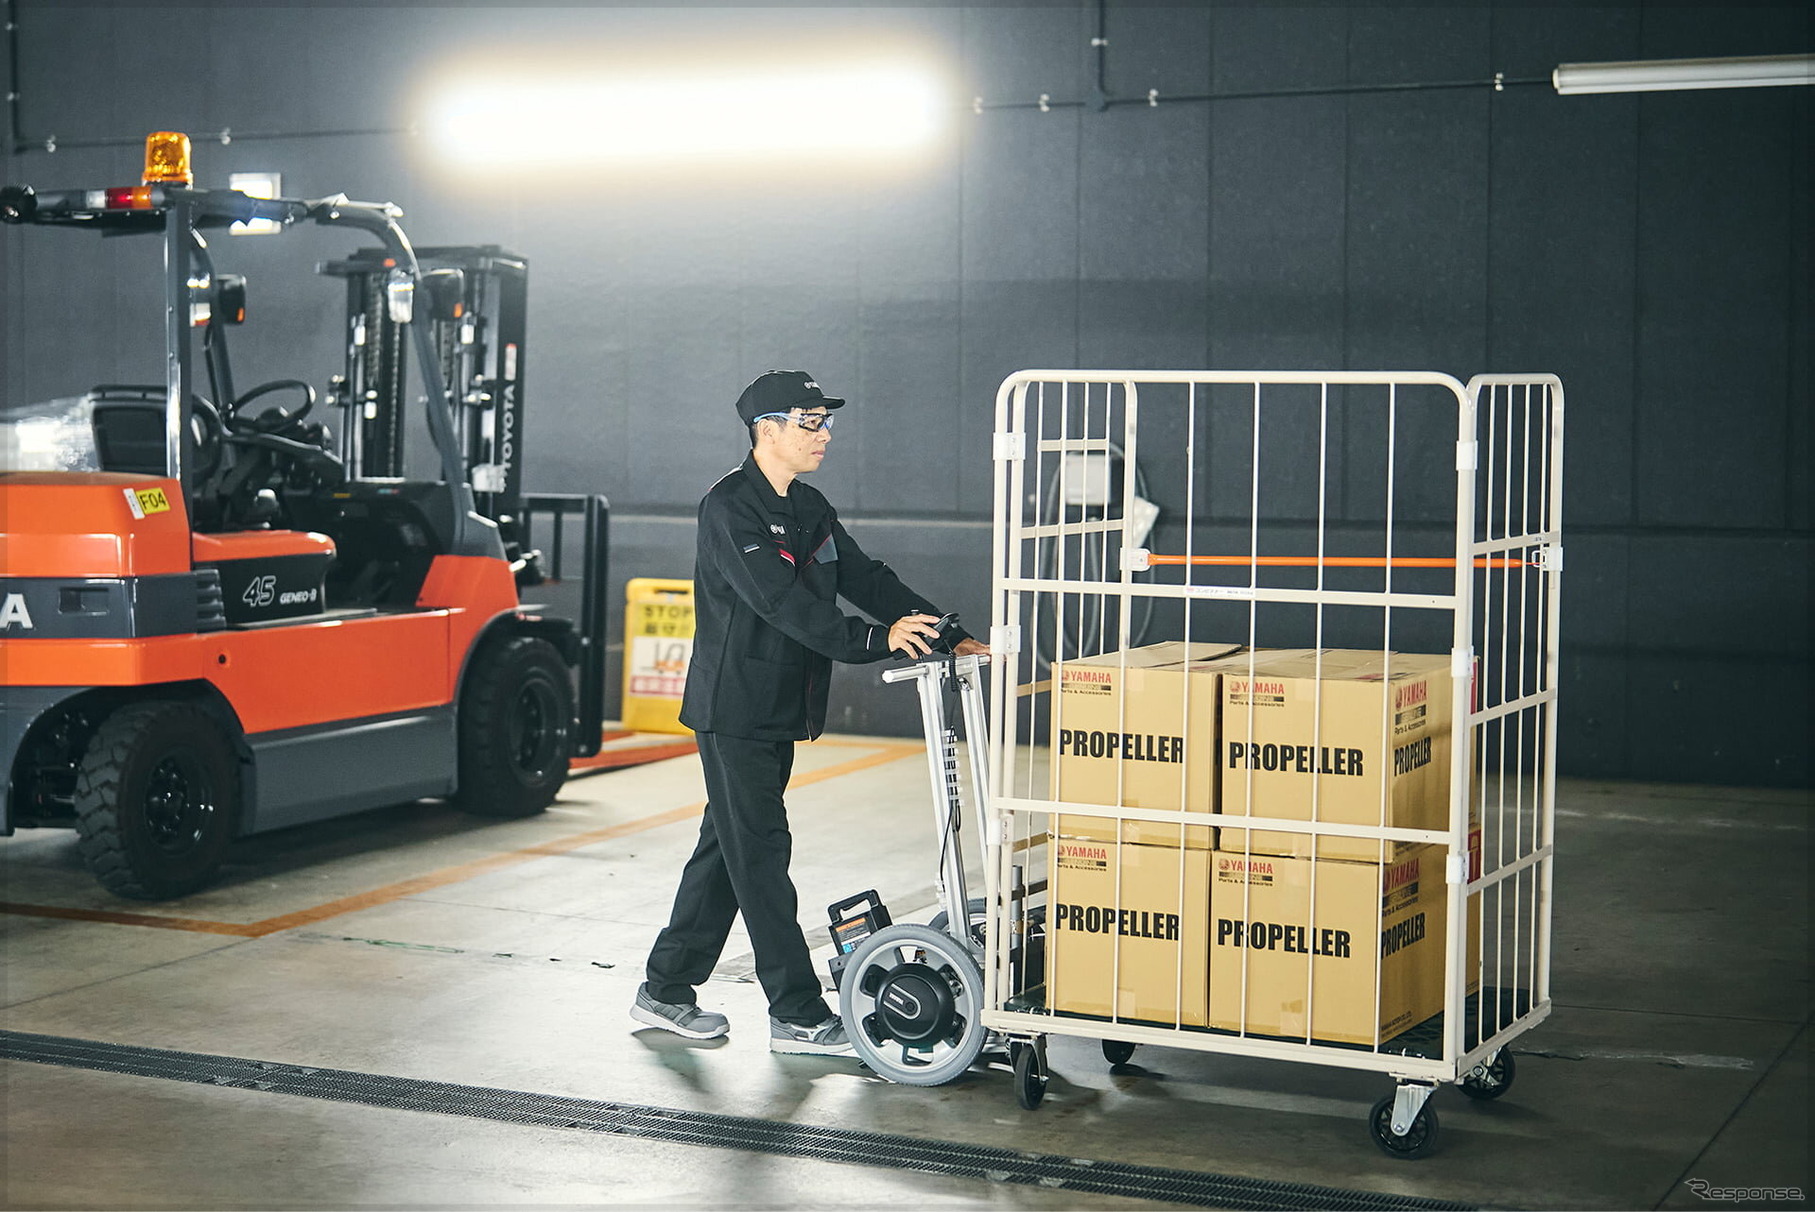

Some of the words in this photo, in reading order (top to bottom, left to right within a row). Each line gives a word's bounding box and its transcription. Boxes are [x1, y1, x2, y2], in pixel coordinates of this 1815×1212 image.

[139, 492, 166, 510] F04
[242, 575, 277, 608] 45
[644, 606, 693, 618] STOP
[1071, 671, 1112, 683] YAMAHA
[1242, 682, 1285, 694] YMAHA
[1402, 680, 1427, 708] YAMAHA
[1060, 729, 1184, 764] PROPELLER
[1229, 742, 1364, 776] PROPELLER
[1394, 736, 1432, 777] PROPELLER
[1066, 846, 1108, 860] YAMAHA
[1390, 858, 1420, 888] YAMAHA
[1056, 903, 1179, 941] PROPELLER
[1381, 911, 1426, 960] PROPELLER
[1217, 919, 1350, 958] PROPELLER
